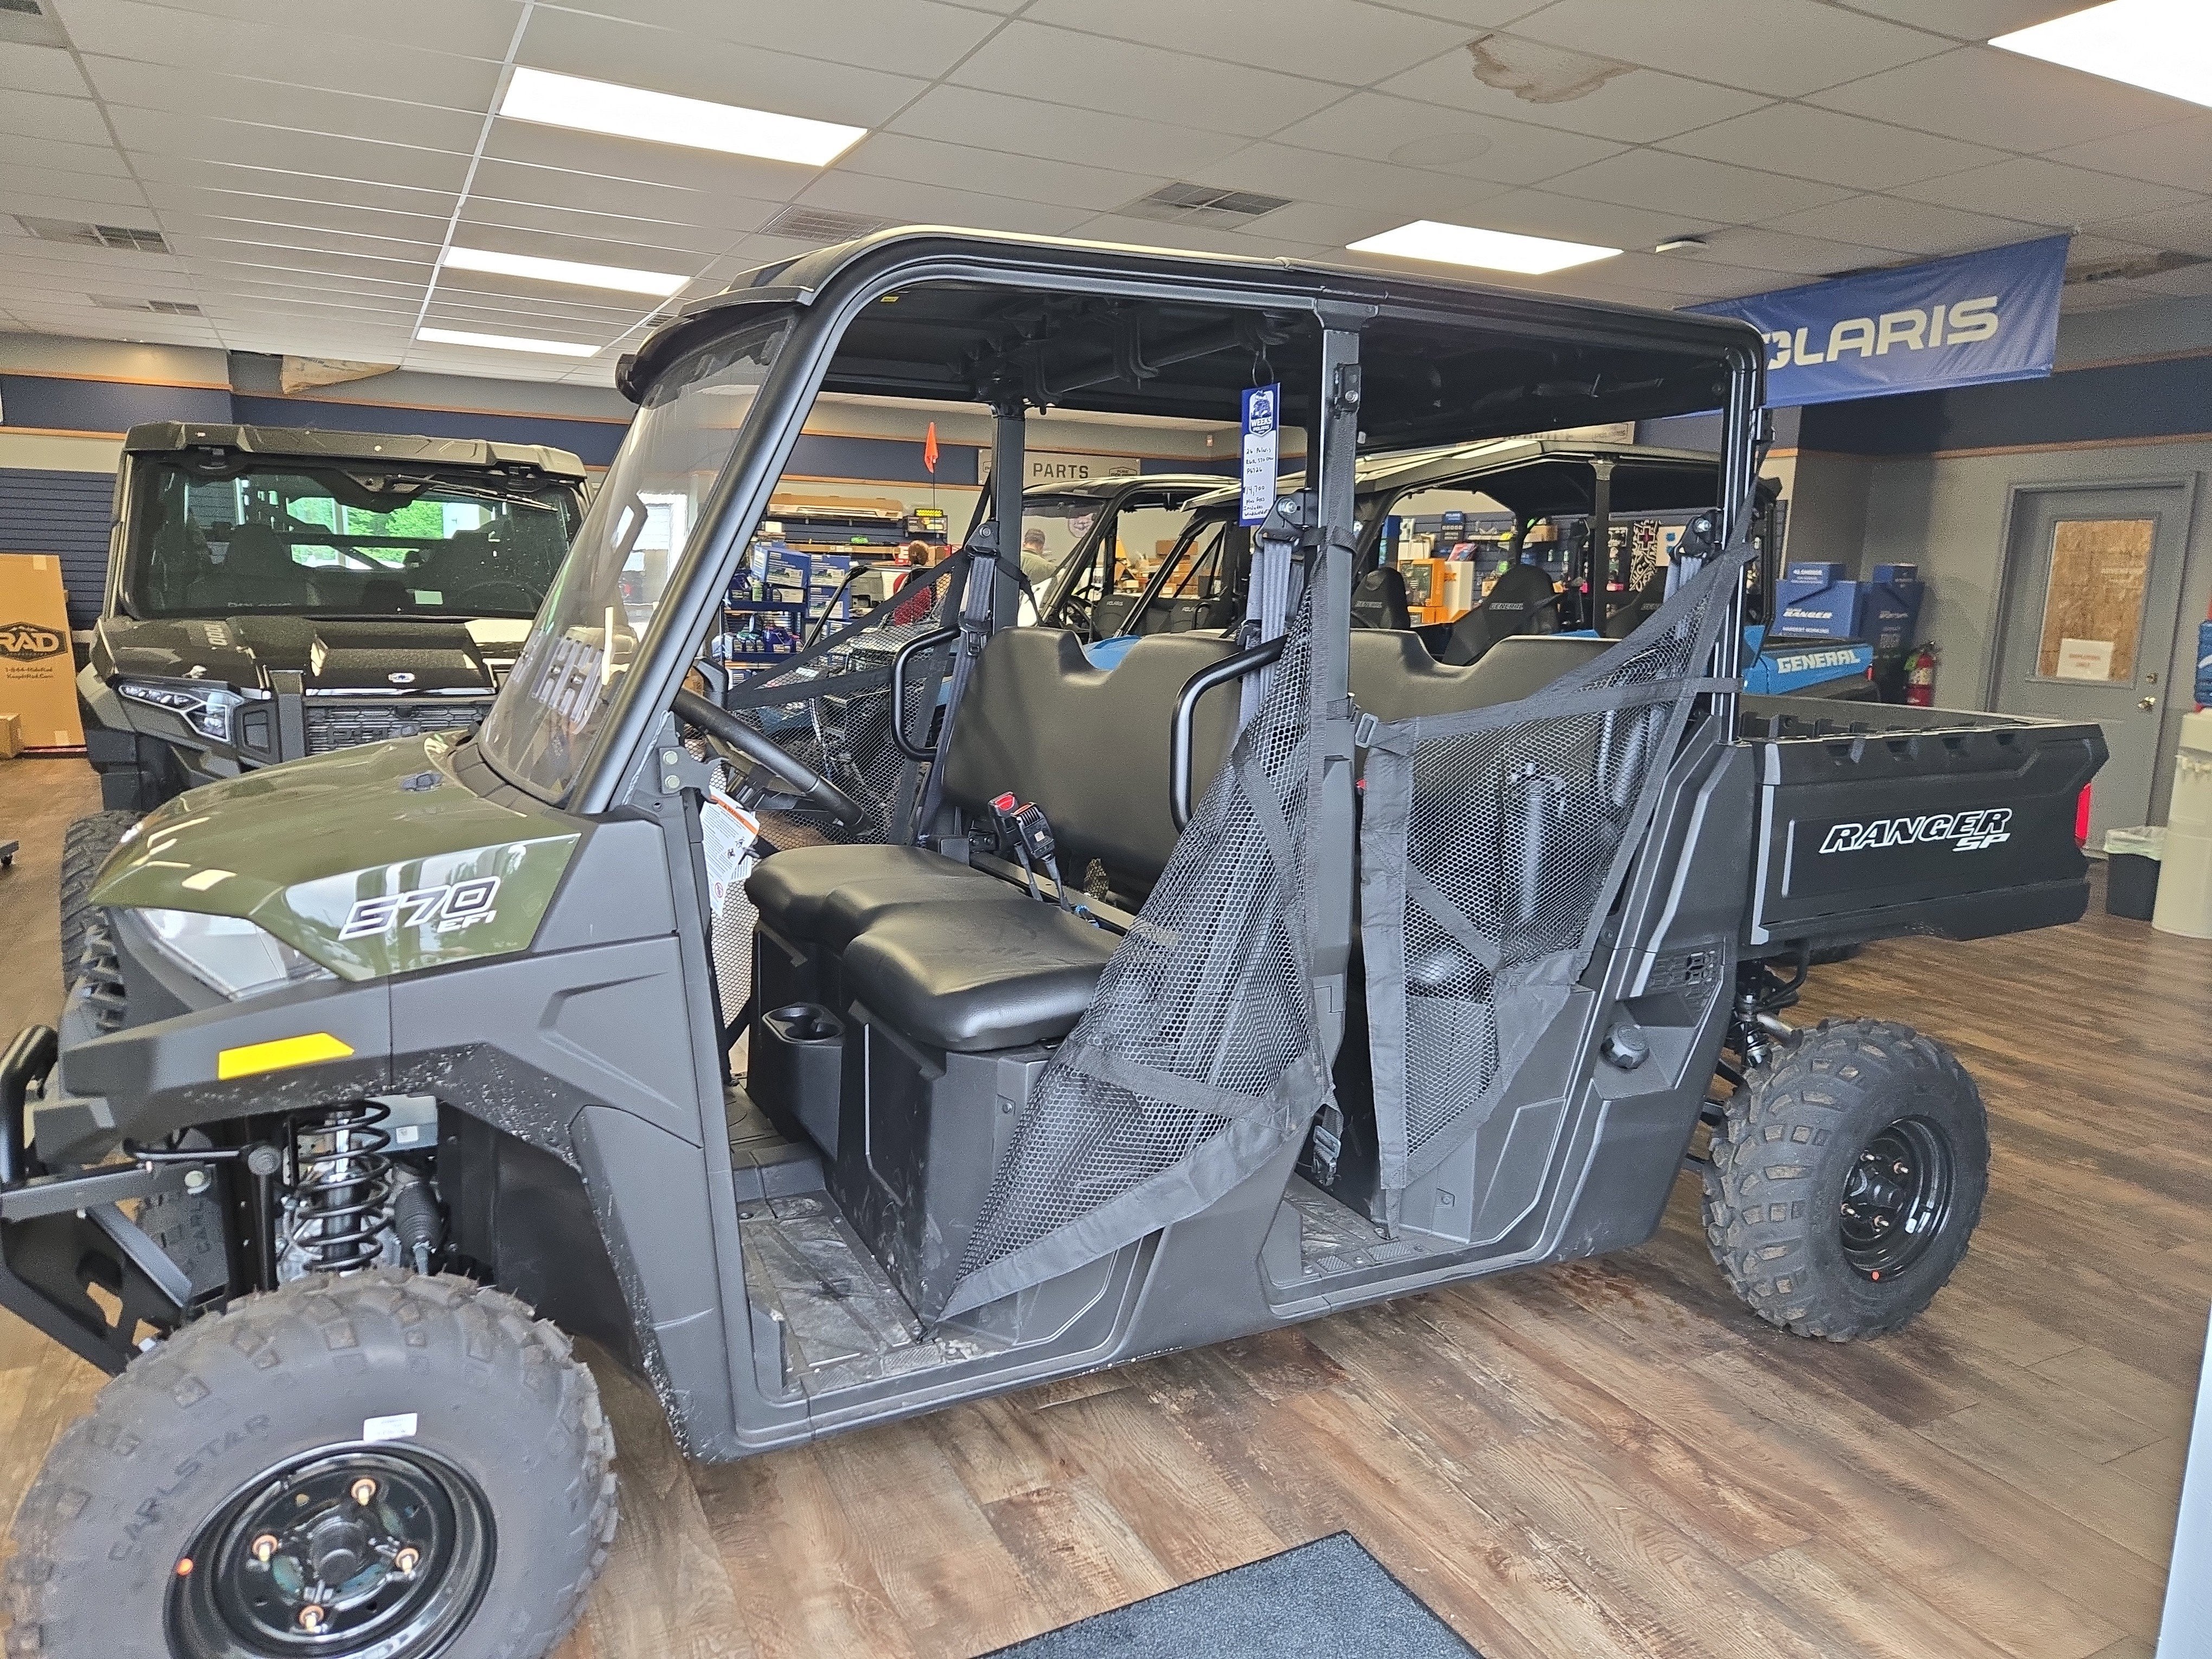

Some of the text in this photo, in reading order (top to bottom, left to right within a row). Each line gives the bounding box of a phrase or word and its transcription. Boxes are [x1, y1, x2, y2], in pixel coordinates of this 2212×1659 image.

[1764, 295, 1999, 370] OLARIS
[1251, 416, 1272, 427] WEEKS
[1033, 462, 1089, 479] PARTS
[0, 632, 60, 652] RAD
[1777, 650, 1861, 674] GENERAL
[1818, 808, 2012, 854] RANGER
[1952, 833, 2011, 852] SP
[338, 876, 501, 941] 570
[437, 910, 497, 934] EFI
[108, 1413, 271, 1561] CARLSTAR
